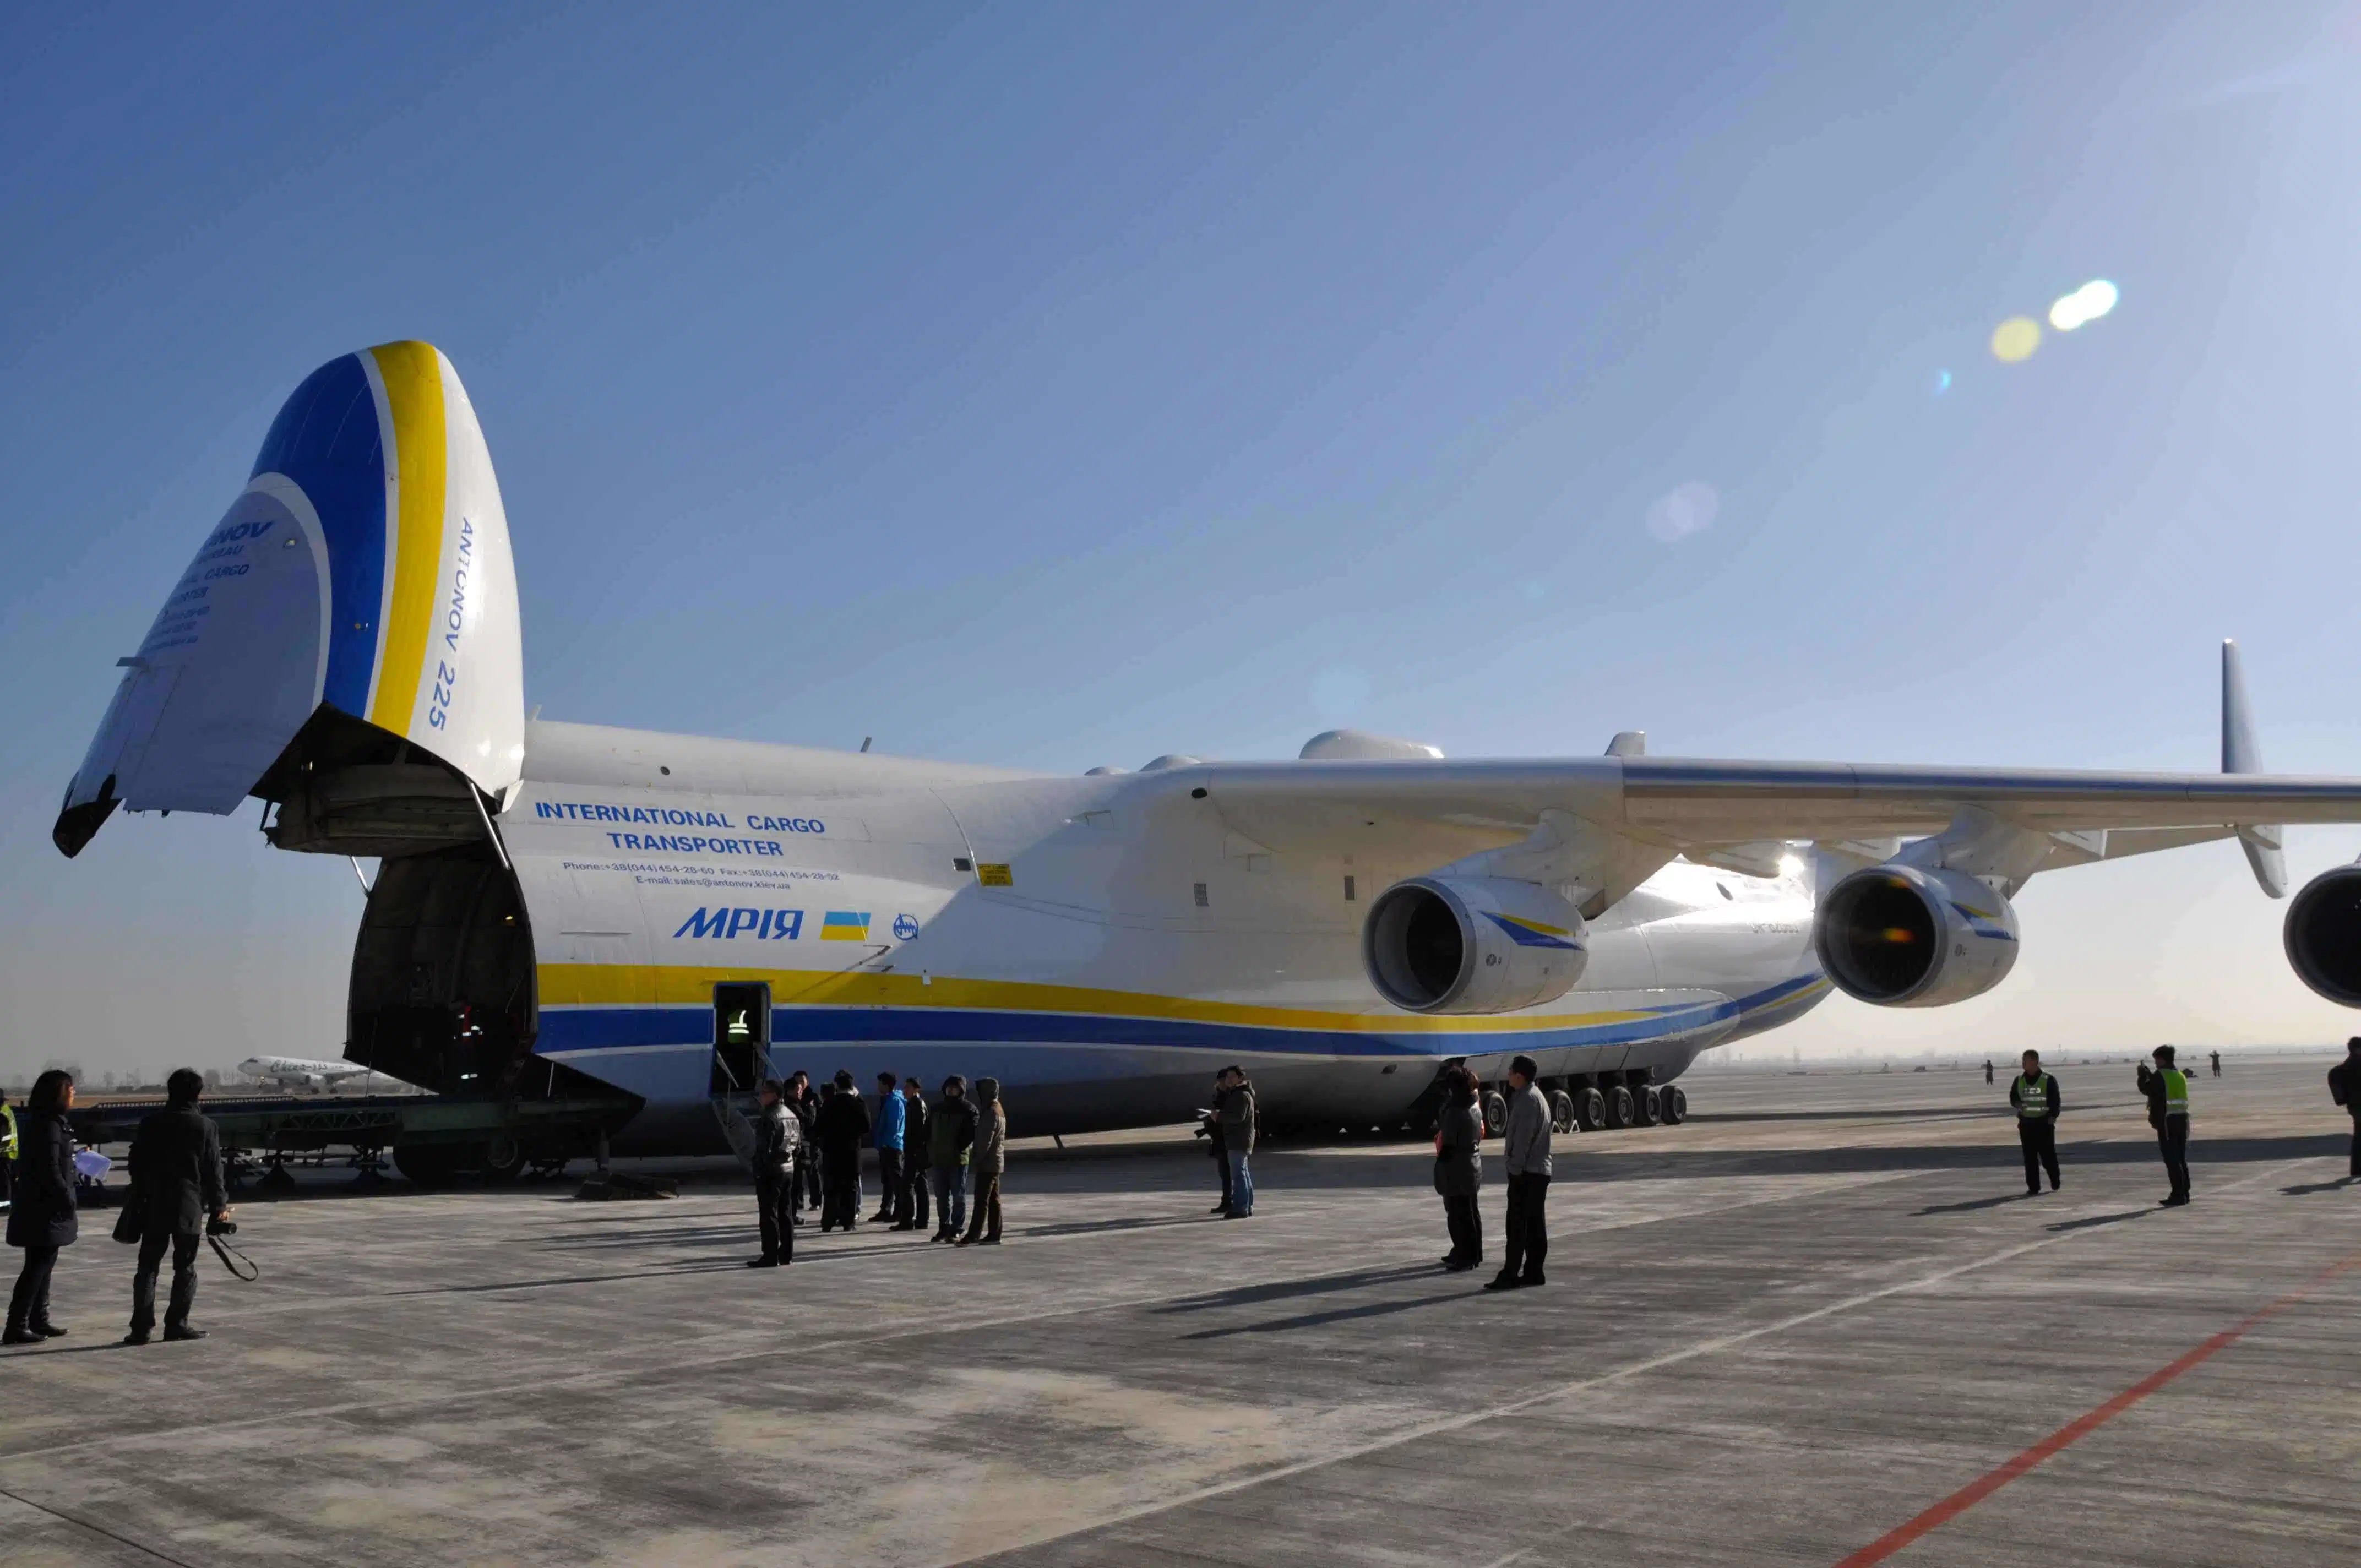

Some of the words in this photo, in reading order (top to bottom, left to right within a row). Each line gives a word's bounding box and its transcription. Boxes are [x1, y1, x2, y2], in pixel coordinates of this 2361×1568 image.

[445, 516, 473, 652] ANTONOV
[429, 659, 456, 731] 225
[535, 802, 736, 828] INTERNATIONAL
[747, 815, 825, 834] CARGO
[607, 832, 784, 856] TRANSPORTER
